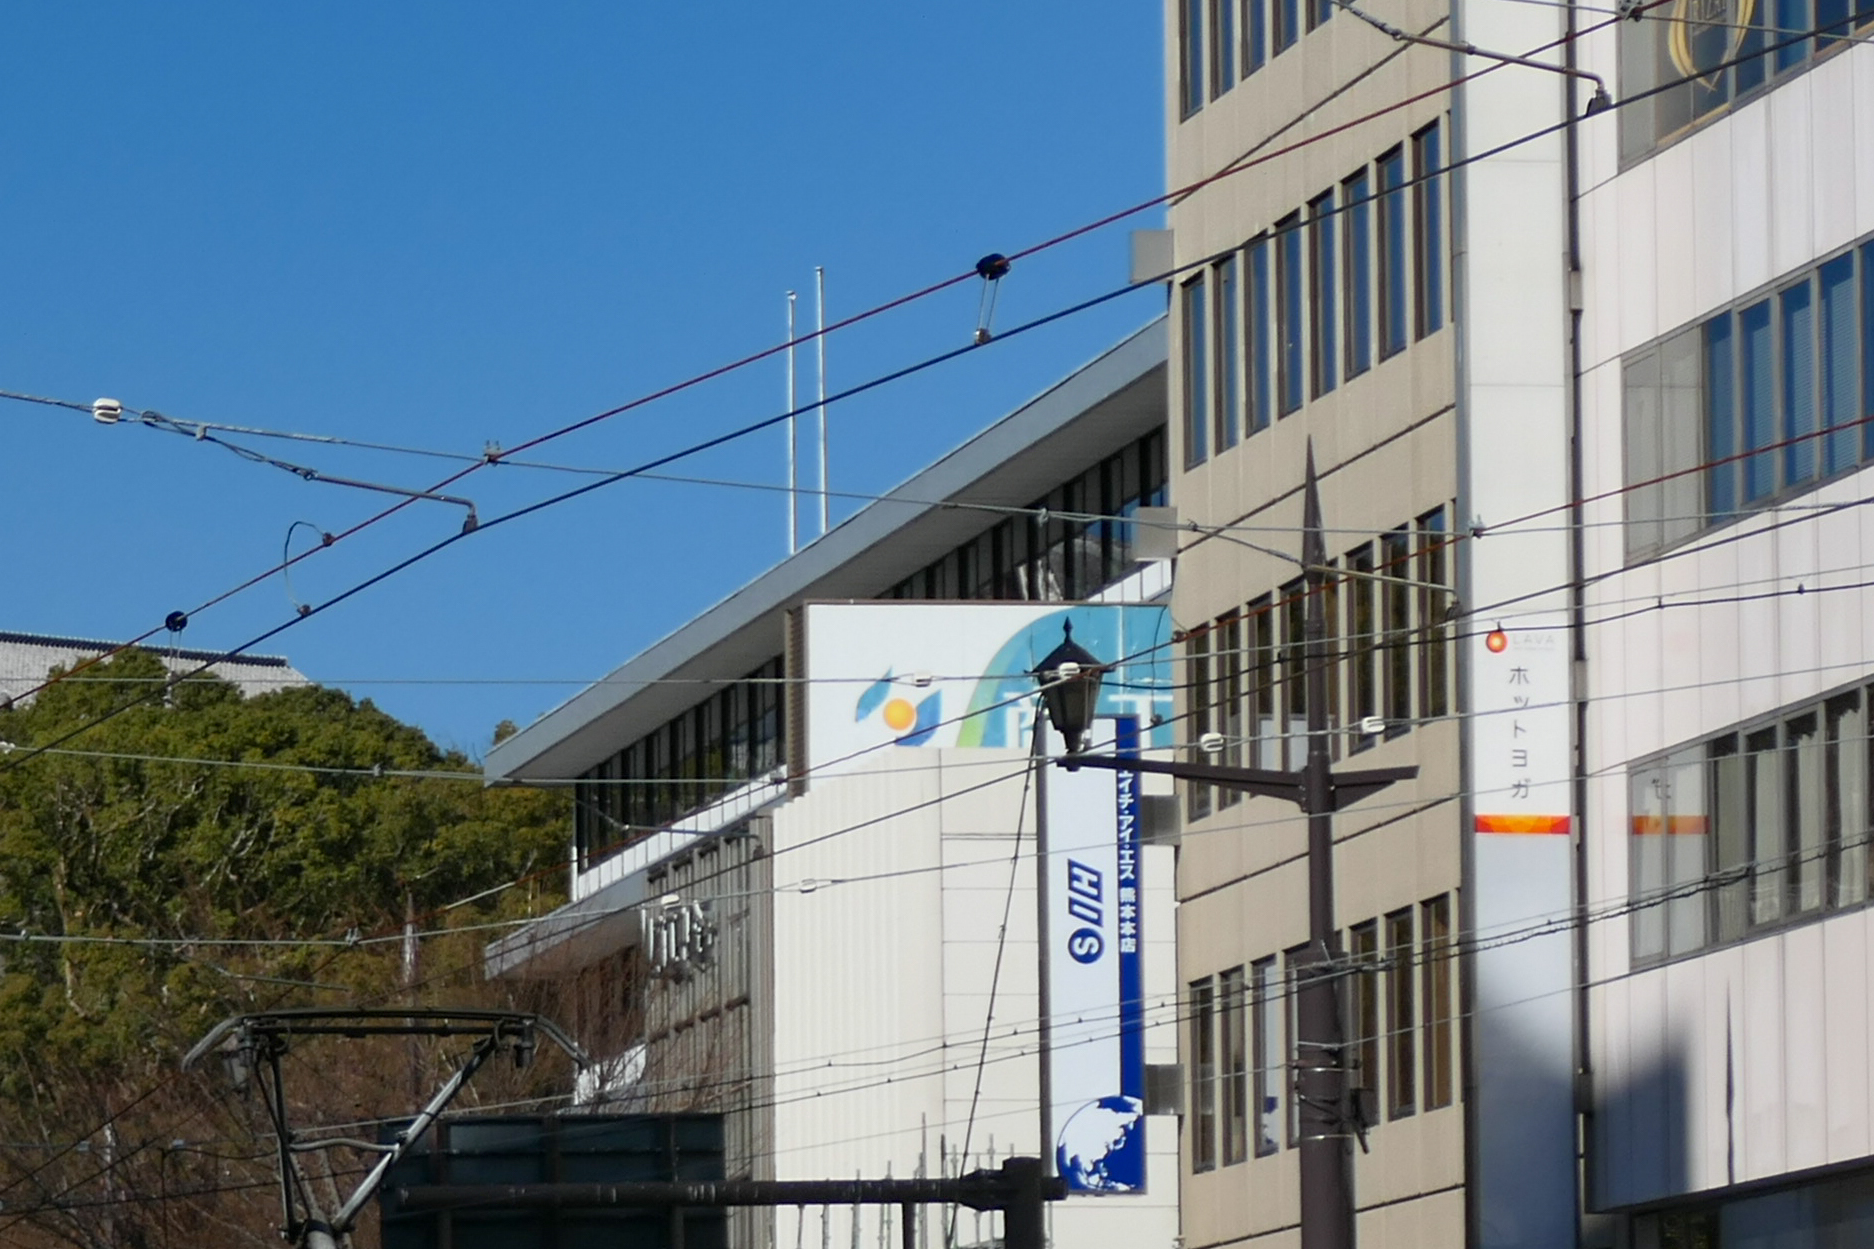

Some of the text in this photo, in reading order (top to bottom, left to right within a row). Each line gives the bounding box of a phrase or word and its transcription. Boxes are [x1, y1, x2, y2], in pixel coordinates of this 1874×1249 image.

[1513, 634, 1556, 645] LAVA
[1508, 666, 1531, 800] ホットヨガ
[1067, 858, 1104, 964] HIS
[1119, 887, 1136, 953] 熊本本店
